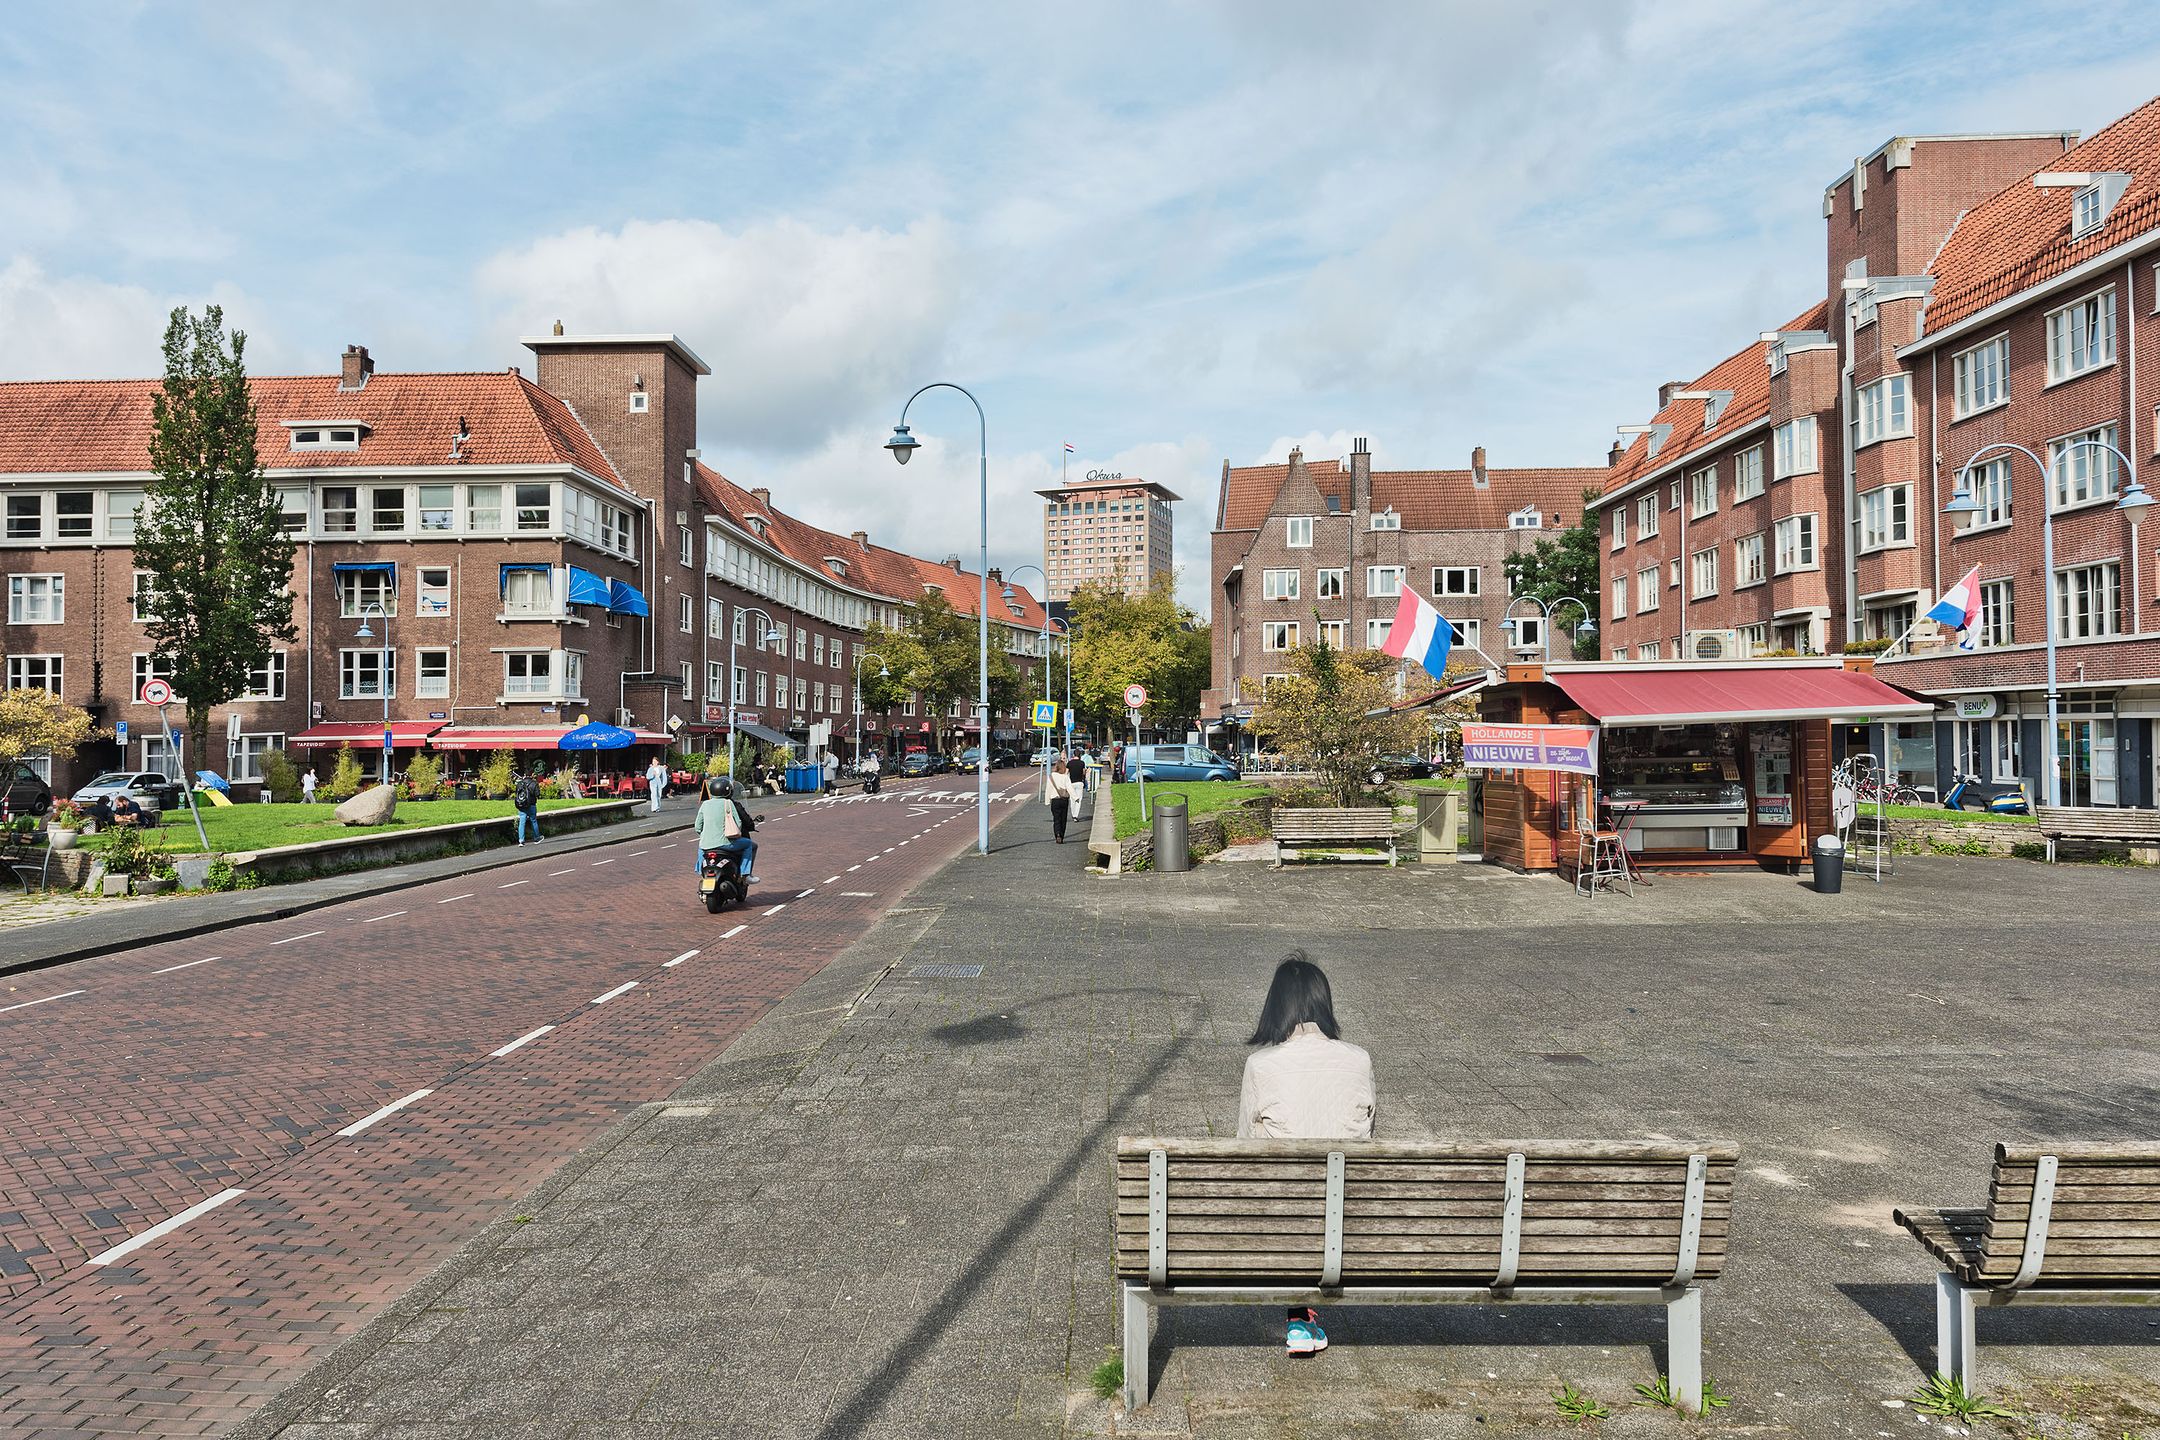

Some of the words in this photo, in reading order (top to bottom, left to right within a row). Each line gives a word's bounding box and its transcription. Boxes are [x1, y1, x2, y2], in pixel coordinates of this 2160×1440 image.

[1086, 468, 1123, 481] Okura
[1963, 701, 1982, 711] BENU
[1471, 729, 1534, 739] HOLLANDSE
[1472, 747, 1535, 761] NIEUWE
